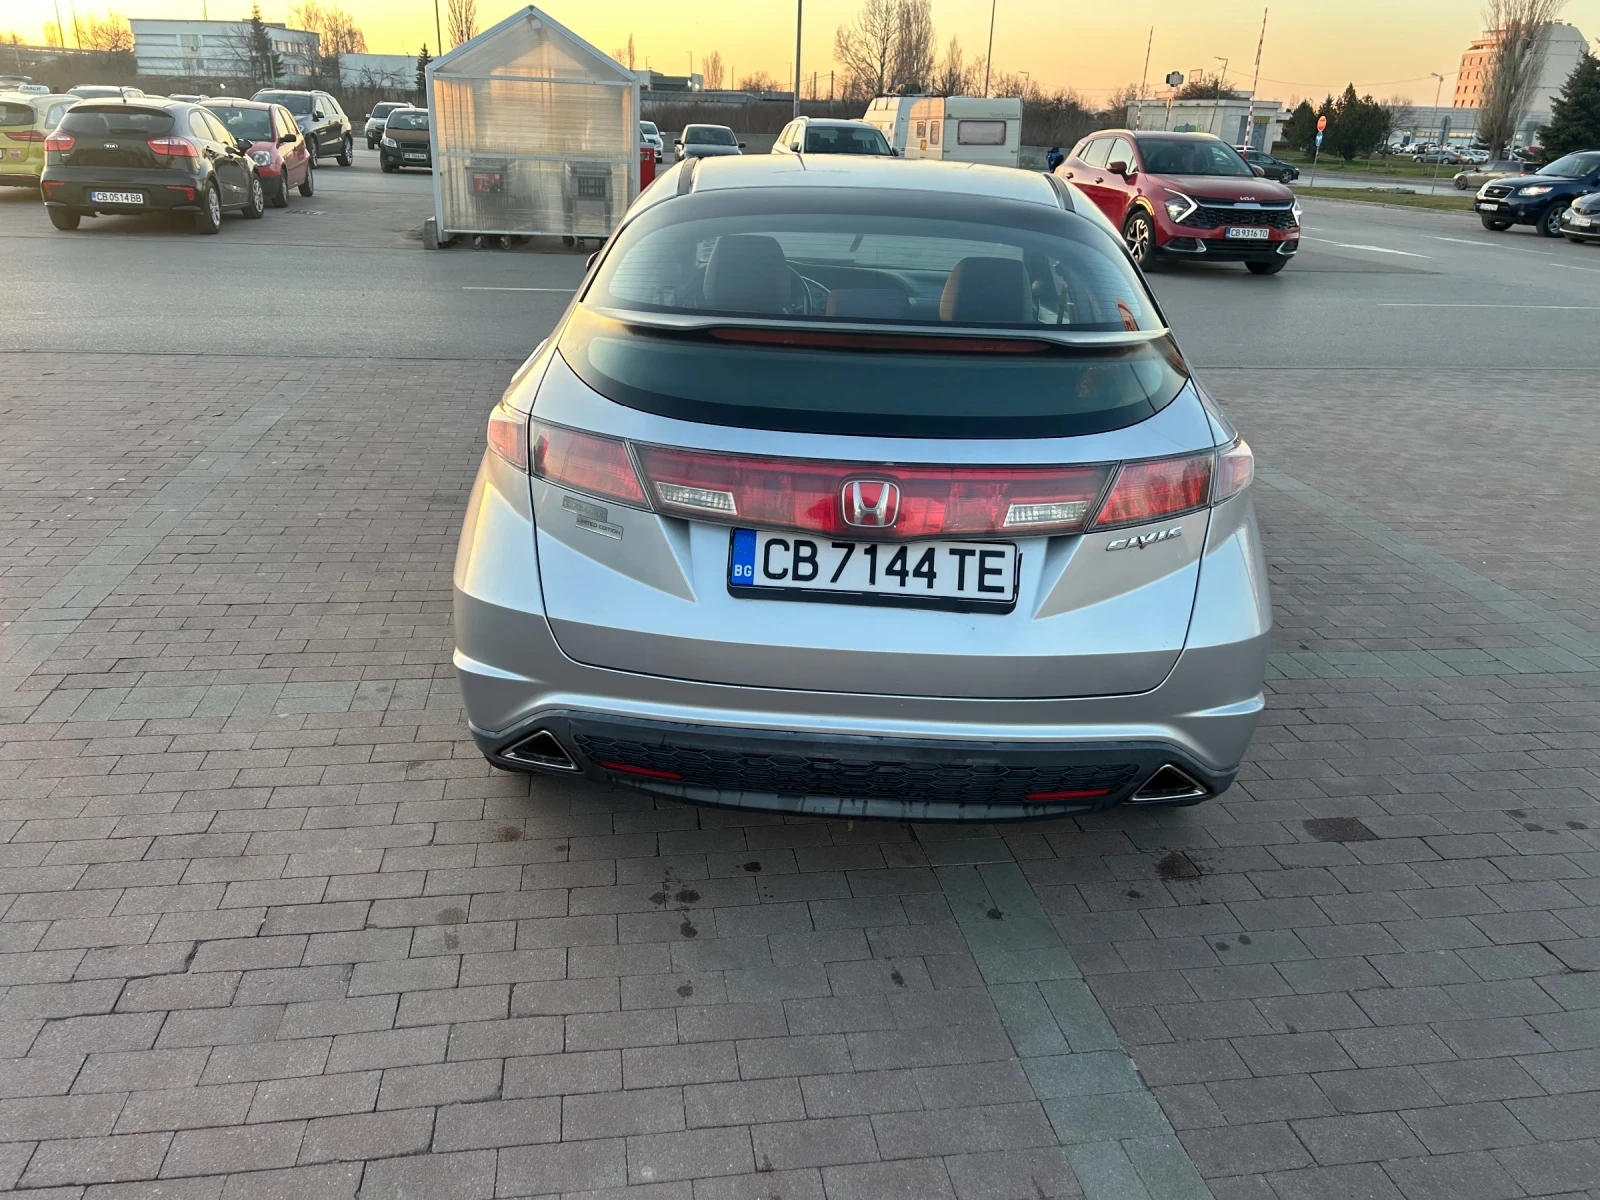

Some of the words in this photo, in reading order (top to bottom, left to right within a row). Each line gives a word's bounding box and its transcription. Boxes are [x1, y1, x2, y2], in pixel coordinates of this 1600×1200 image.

[96, 193, 108, 201] CB
[1231, 229, 1241, 237] CB
[598, 525, 621, 535] EDITION
[1106, 526, 1182, 551] CIVIC
[734, 564, 752, 578] BG
[763, 538, 819, 582] CB
[830, 541, 937, 589] 7144
[949, 549, 1005, 593] TE
